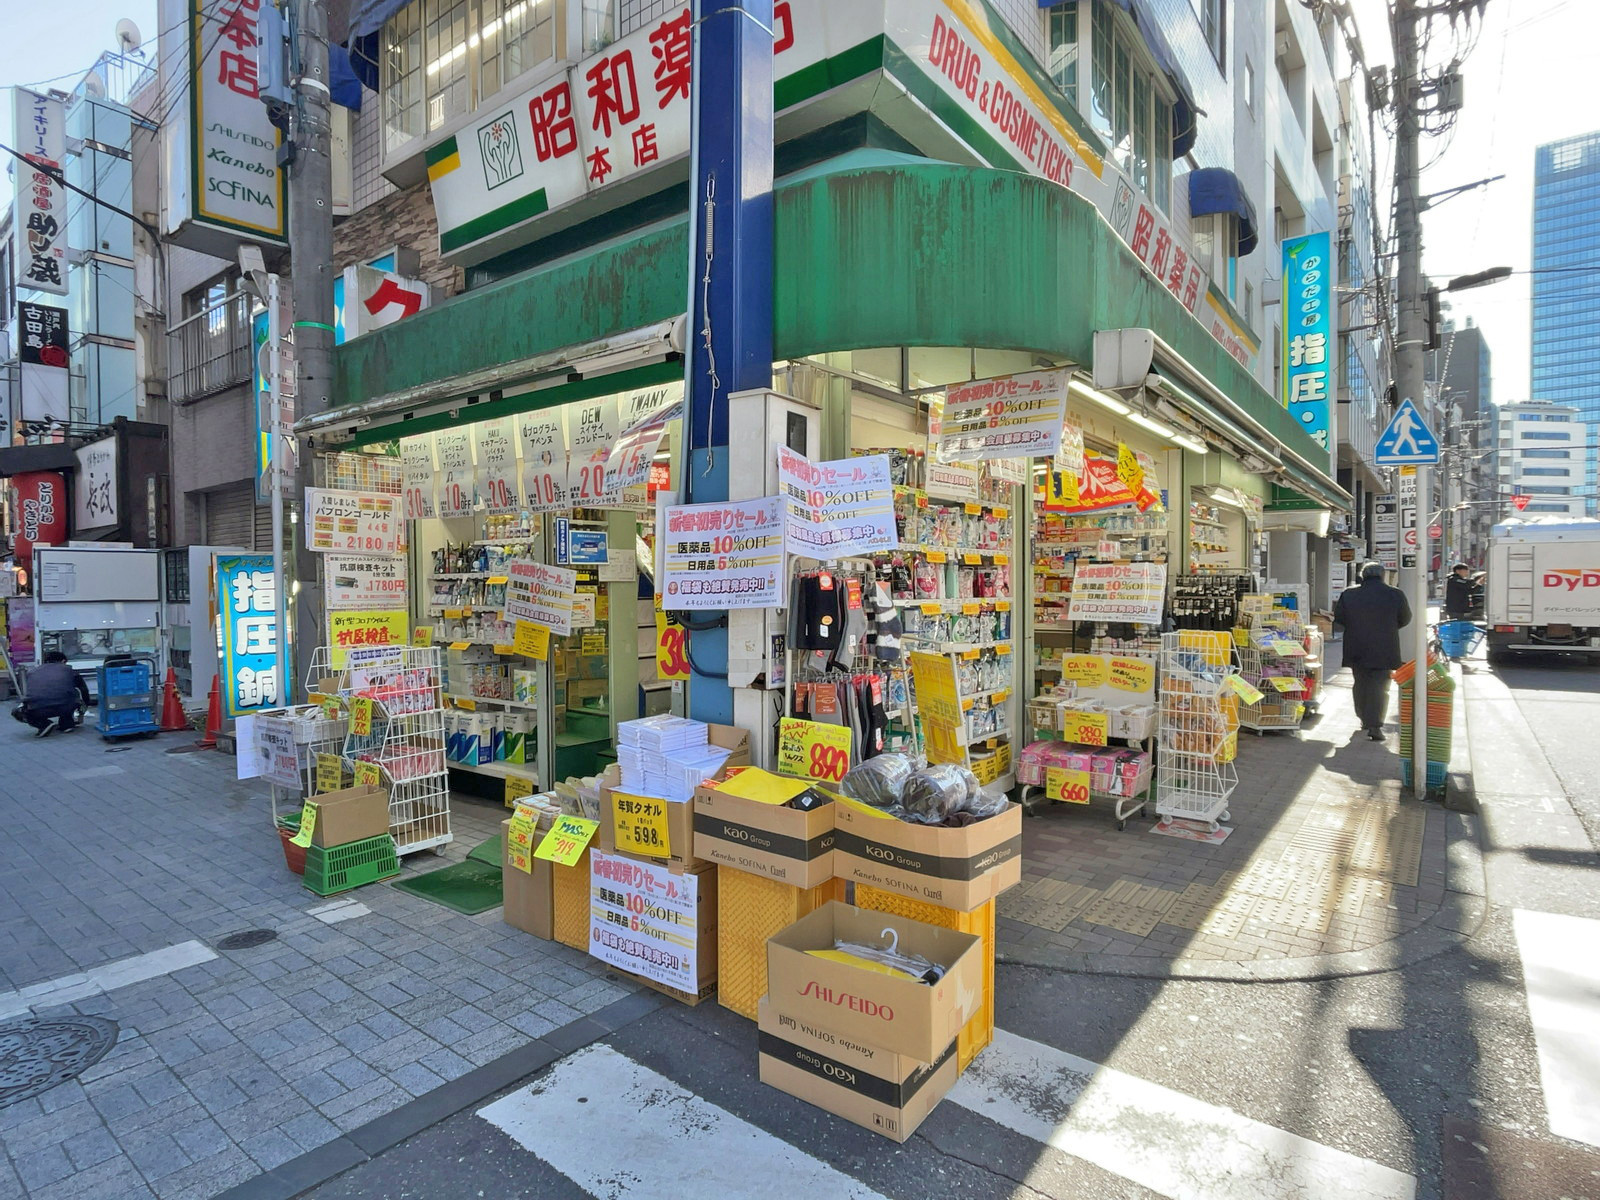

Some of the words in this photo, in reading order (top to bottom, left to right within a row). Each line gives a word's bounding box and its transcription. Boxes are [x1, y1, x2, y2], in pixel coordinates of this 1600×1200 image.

[928, 13, 981, 103] DRUG
[979, 80, 990, 115] &
[990, 80, 1073, 187] COSMETICKS
[207, 122, 275, 151] SHISEIDO
[207, 147, 275, 178] Kanebo
[587, 123, 660, 185] 本店
[208, 176, 275, 210] SOFINA
[1131, 203, 1200, 313] 昭和薬品
[631, 389, 668, 413] TWANY
[581, 406, 601, 425] DEW
[961, 420, 987, 432] 日用品
[618, 445, 644, 480] 15
[533, 473, 554, 504] 10
[580, 464, 604, 498] 20
[407, 487, 423, 518] 30
[445, 483, 460, 511] 10
[488, 479, 508, 508] 20
[315, 507, 391, 519] パブロンゴールド
[669, 509, 767, 533] 新春初売りセール
[346, 536, 383, 550] 2180
[677, 541, 711, 554] 医薬品
[339, 563, 396, 573] 抗原検査キット
[688, 560, 716, 571] 日用品
[336, 626, 390, 645] 抗原検査
[1078, 725, 1102, 738] 980
[809, 742, 849, 782] 890
[1061, 782, 1089, 802] 660
[618, 799, 662, 816] 年賀タオル
[749, 834, 771, 848] Group
[710, 849, 736, 863] Kanebo
[738, 857, 767, 872] SOFINA
[896, 855, 922, 869] Group
[593, 859, 678, 899] 新春初売りセール
[853, 868, 882, 883] Kanebo
[885, 877, 919, 893] SOFINA
[600, 887, 625, 907] 医薬品
[606, 910, 629, 928] 日用品
[796, 981, 894, 1022] SHISEIDO
[800, 1022, 836, 1045] SOFINA
[796, 1050, 822, 1069] Group
[839, 1038, 875, 1059] Kanebo
